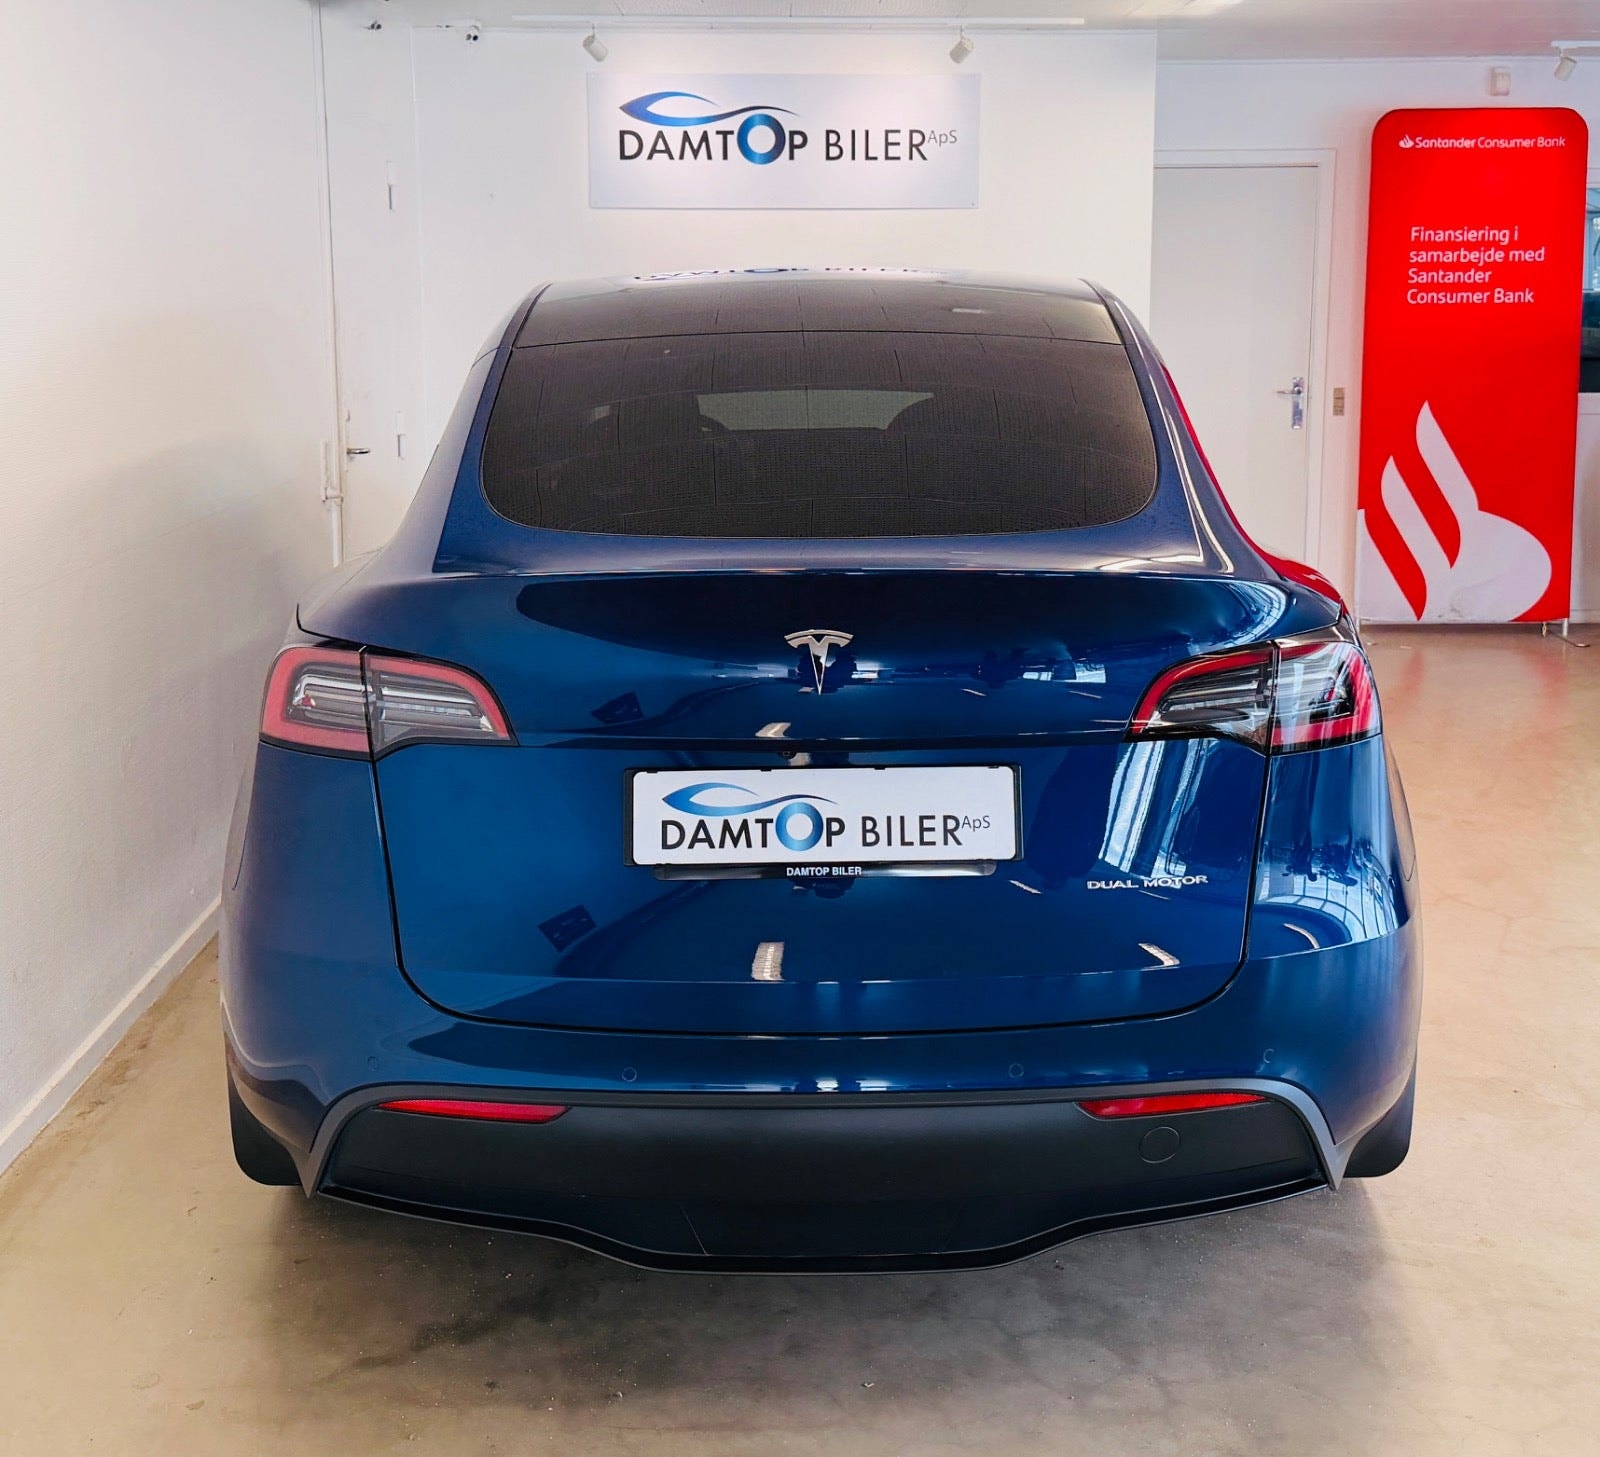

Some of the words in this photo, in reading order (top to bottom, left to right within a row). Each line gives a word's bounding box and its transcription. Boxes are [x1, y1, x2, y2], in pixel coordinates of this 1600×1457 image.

[619, 113, 808, 165] DAMTOP
[825, 129, 928, 161] BILER
[927, 130, 958, 147] ApS
[1415, 137, 1476, 148] Santander
[1477, 137, 1535, 148] Consumer
[1537, 136, 1566, 147] Bank
[1410, 227, 1509, 245] Finansiering
[1514, 226, 1519, 241] i
[1409, 247, 1504, 266] samarbejde
[1509, 247, 1545, 262] med
[1408, 268, 1492, 283] Santander
[1407, 289, 1489, 304] Consumer
[1494, 288, 1534, 303] Bank
[661, 802, 845, 851] DAMTOP
[861, 814, 963, 848] BILER
[961, 815, 991, 831] ApS
[786, 867, 829, 876] DAMTOP
[832, 866, 862, 876] BILER
[1087, 880, 1139, 889] DUAL
[1143, 875, 1208, 888] MOTOR
